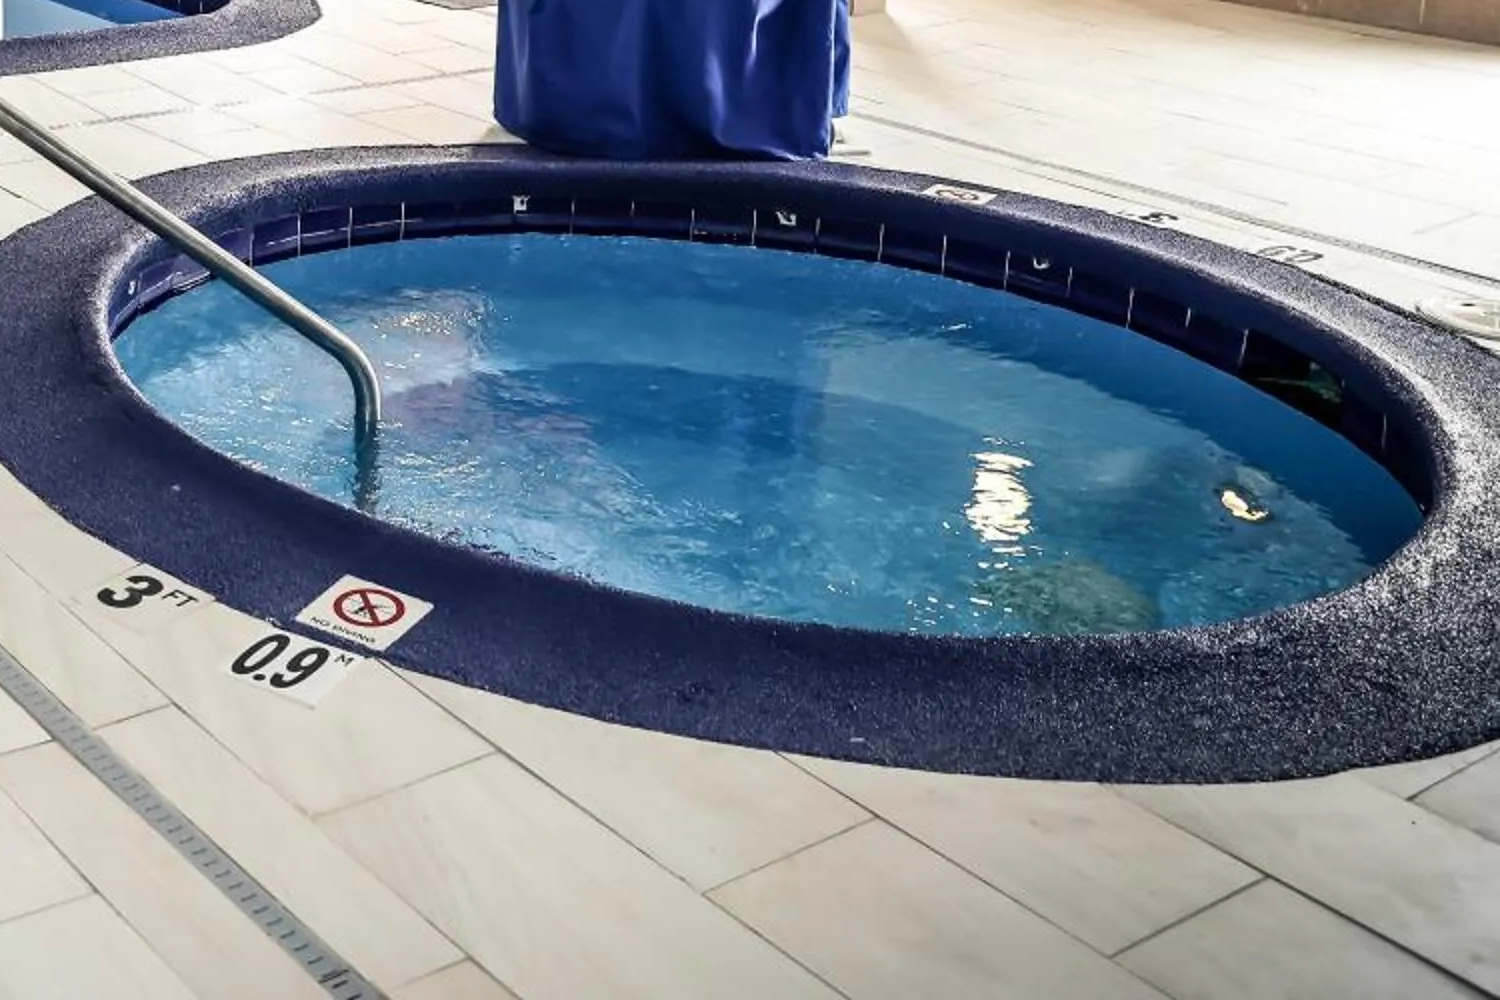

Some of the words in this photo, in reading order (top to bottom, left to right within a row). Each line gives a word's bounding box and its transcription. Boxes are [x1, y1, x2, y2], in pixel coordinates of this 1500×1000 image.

[97, 575, 164, 608] 3
[161, 588, 199, 608] FT
[310, 616, 331, 627] NO
[332, 624, 378, 644] DIVING
[231, 633, 331, 689] 0.9
